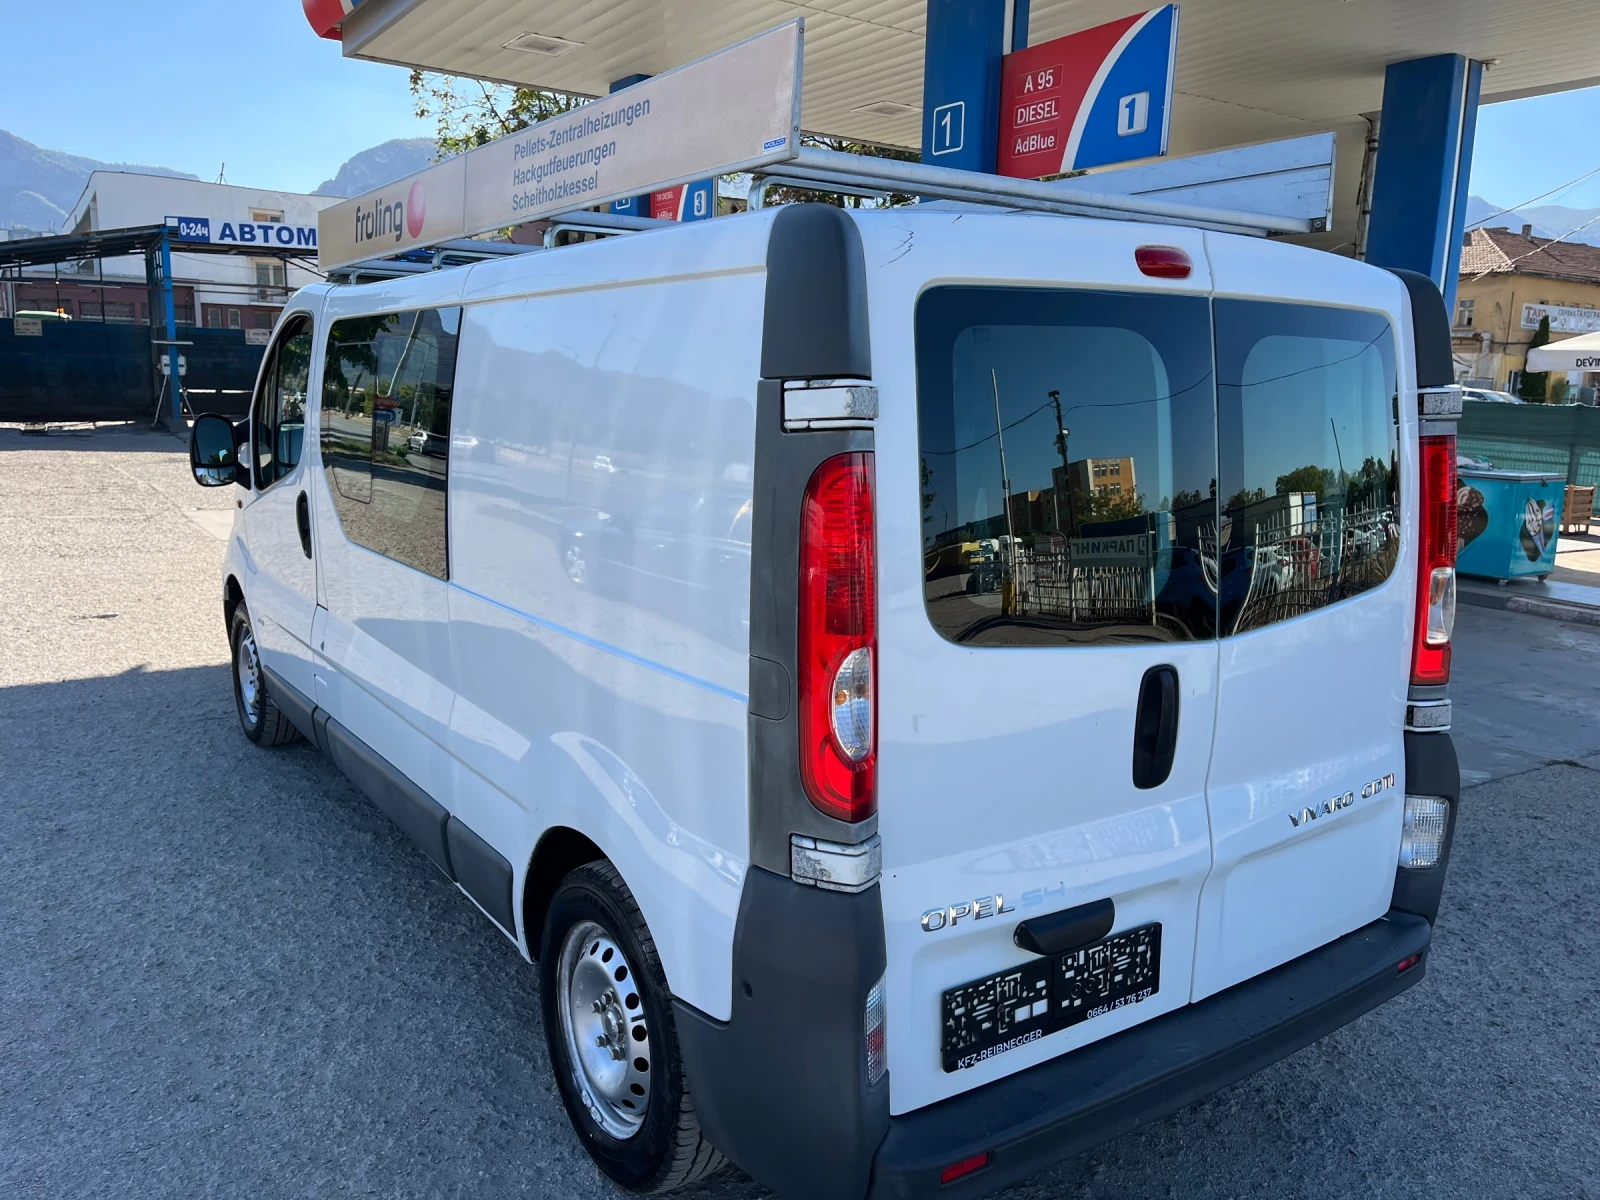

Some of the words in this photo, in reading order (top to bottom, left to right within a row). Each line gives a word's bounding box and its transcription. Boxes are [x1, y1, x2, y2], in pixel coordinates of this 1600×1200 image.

[1024, 75, 1034, 94] A
[1037, 70, 1054, 90] 95
[941, 111, 951, 147] 1
[1017, 100, 1059, 124] DIESEL
[1124, 97, 1137, 130] 1
[514, 99, 650, 161] Pellets-Zentralheizungen
[1015, 134, 1055, 154] AdBlue
[513, 140, 616, 186] Hackgutfeuerungen
[512, 170, 598, 211] Scheitholzkessel
[696, 192, 702, 213] 3
[219, 222, 317, 246] АВТОМ
[1288, 790, 1354, 827] VIVARO
[1361, 773, 1395, 799] CDTI
[920, 893, 1015, 932] OPEL
[1086, 1003, 1109, 1019] 0664
[1115, 997, 1125, 1009] 53
[1126, 993, 1137, 1004] 76
[1137, 987, 1152, 1000] 237
[957, 1028, 1043, 1069] KFZ-REIBNEGGER
